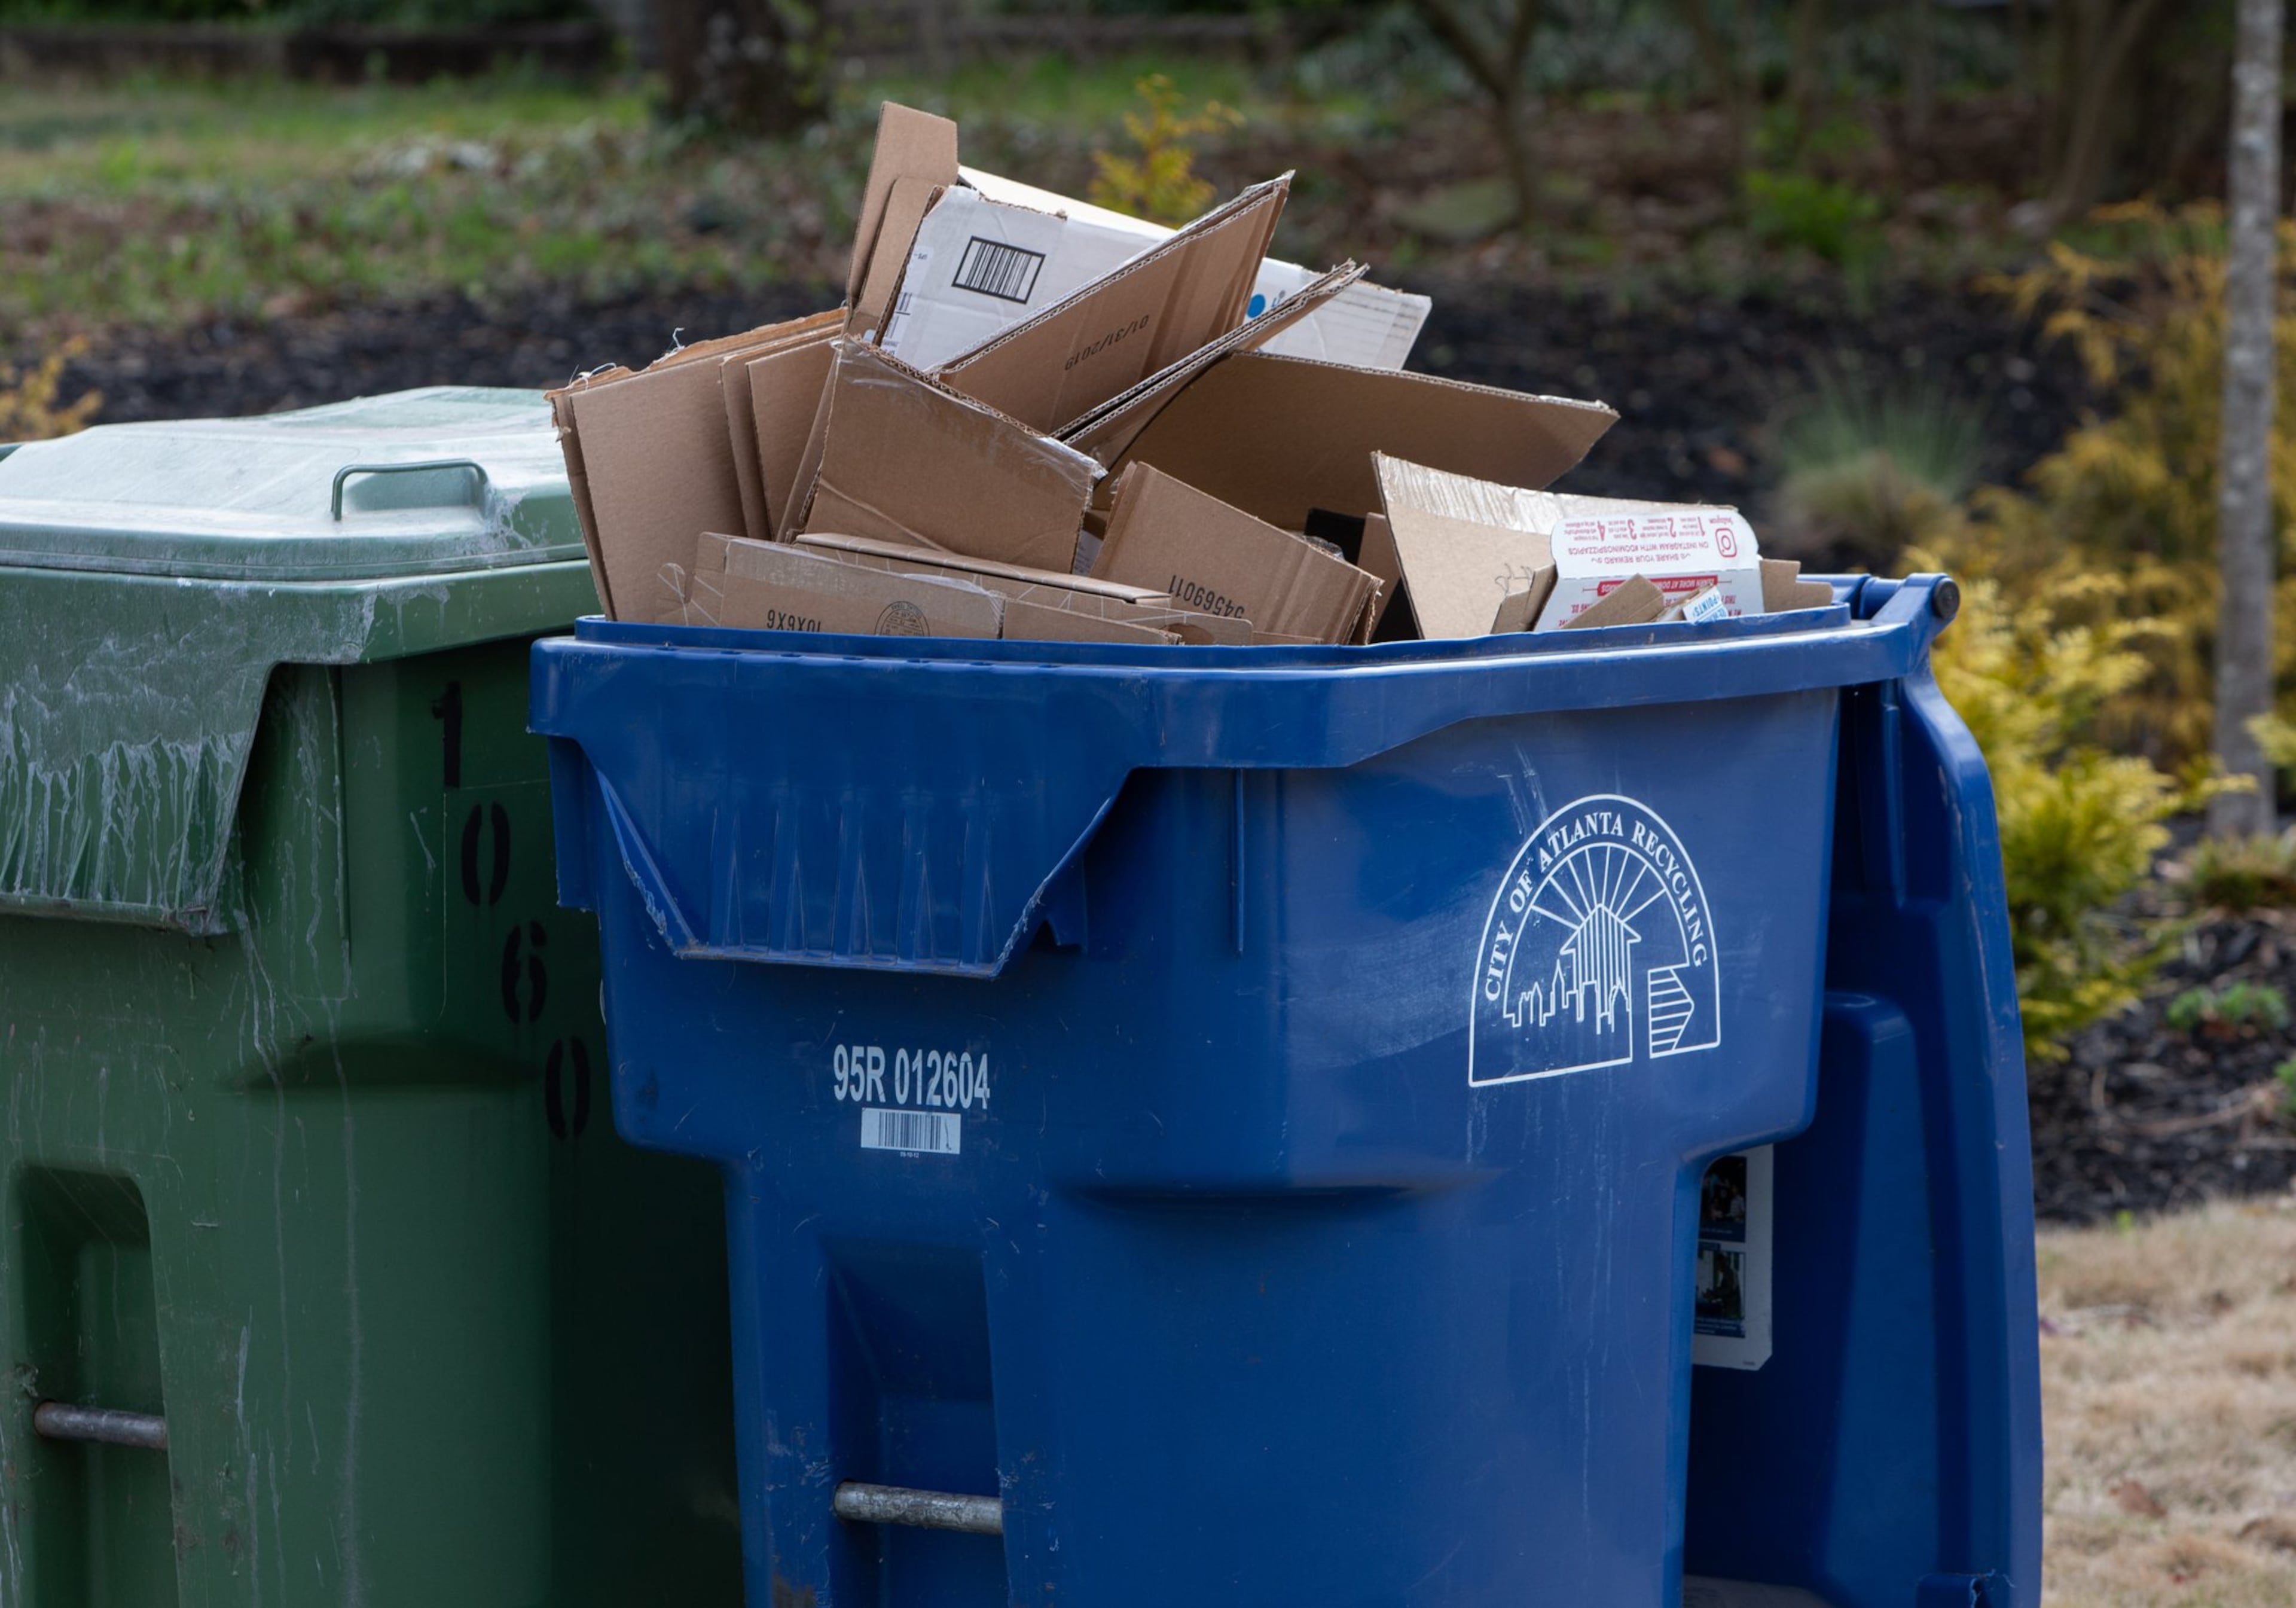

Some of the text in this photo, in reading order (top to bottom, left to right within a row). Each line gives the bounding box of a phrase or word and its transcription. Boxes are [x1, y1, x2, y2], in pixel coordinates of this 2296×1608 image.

[1064, 315, 1149, 371] 01/31/2019
[1596, 520, 1606, 542] 4
[1627, 518, 1638, 541] 3
[1666, 517, 1677, 538] 2
[1640, 544, 1657, 553] WITH
[1658, 541, 1697, 551] INSTAGRAM
[1604, 553, 1680, 565] SHARE YOUR REWARD
[1485, 811, 1708, 1001] CITY OF ATLANTA RECYCLING
[833, 1044, 990, 1109] 95R 012604
